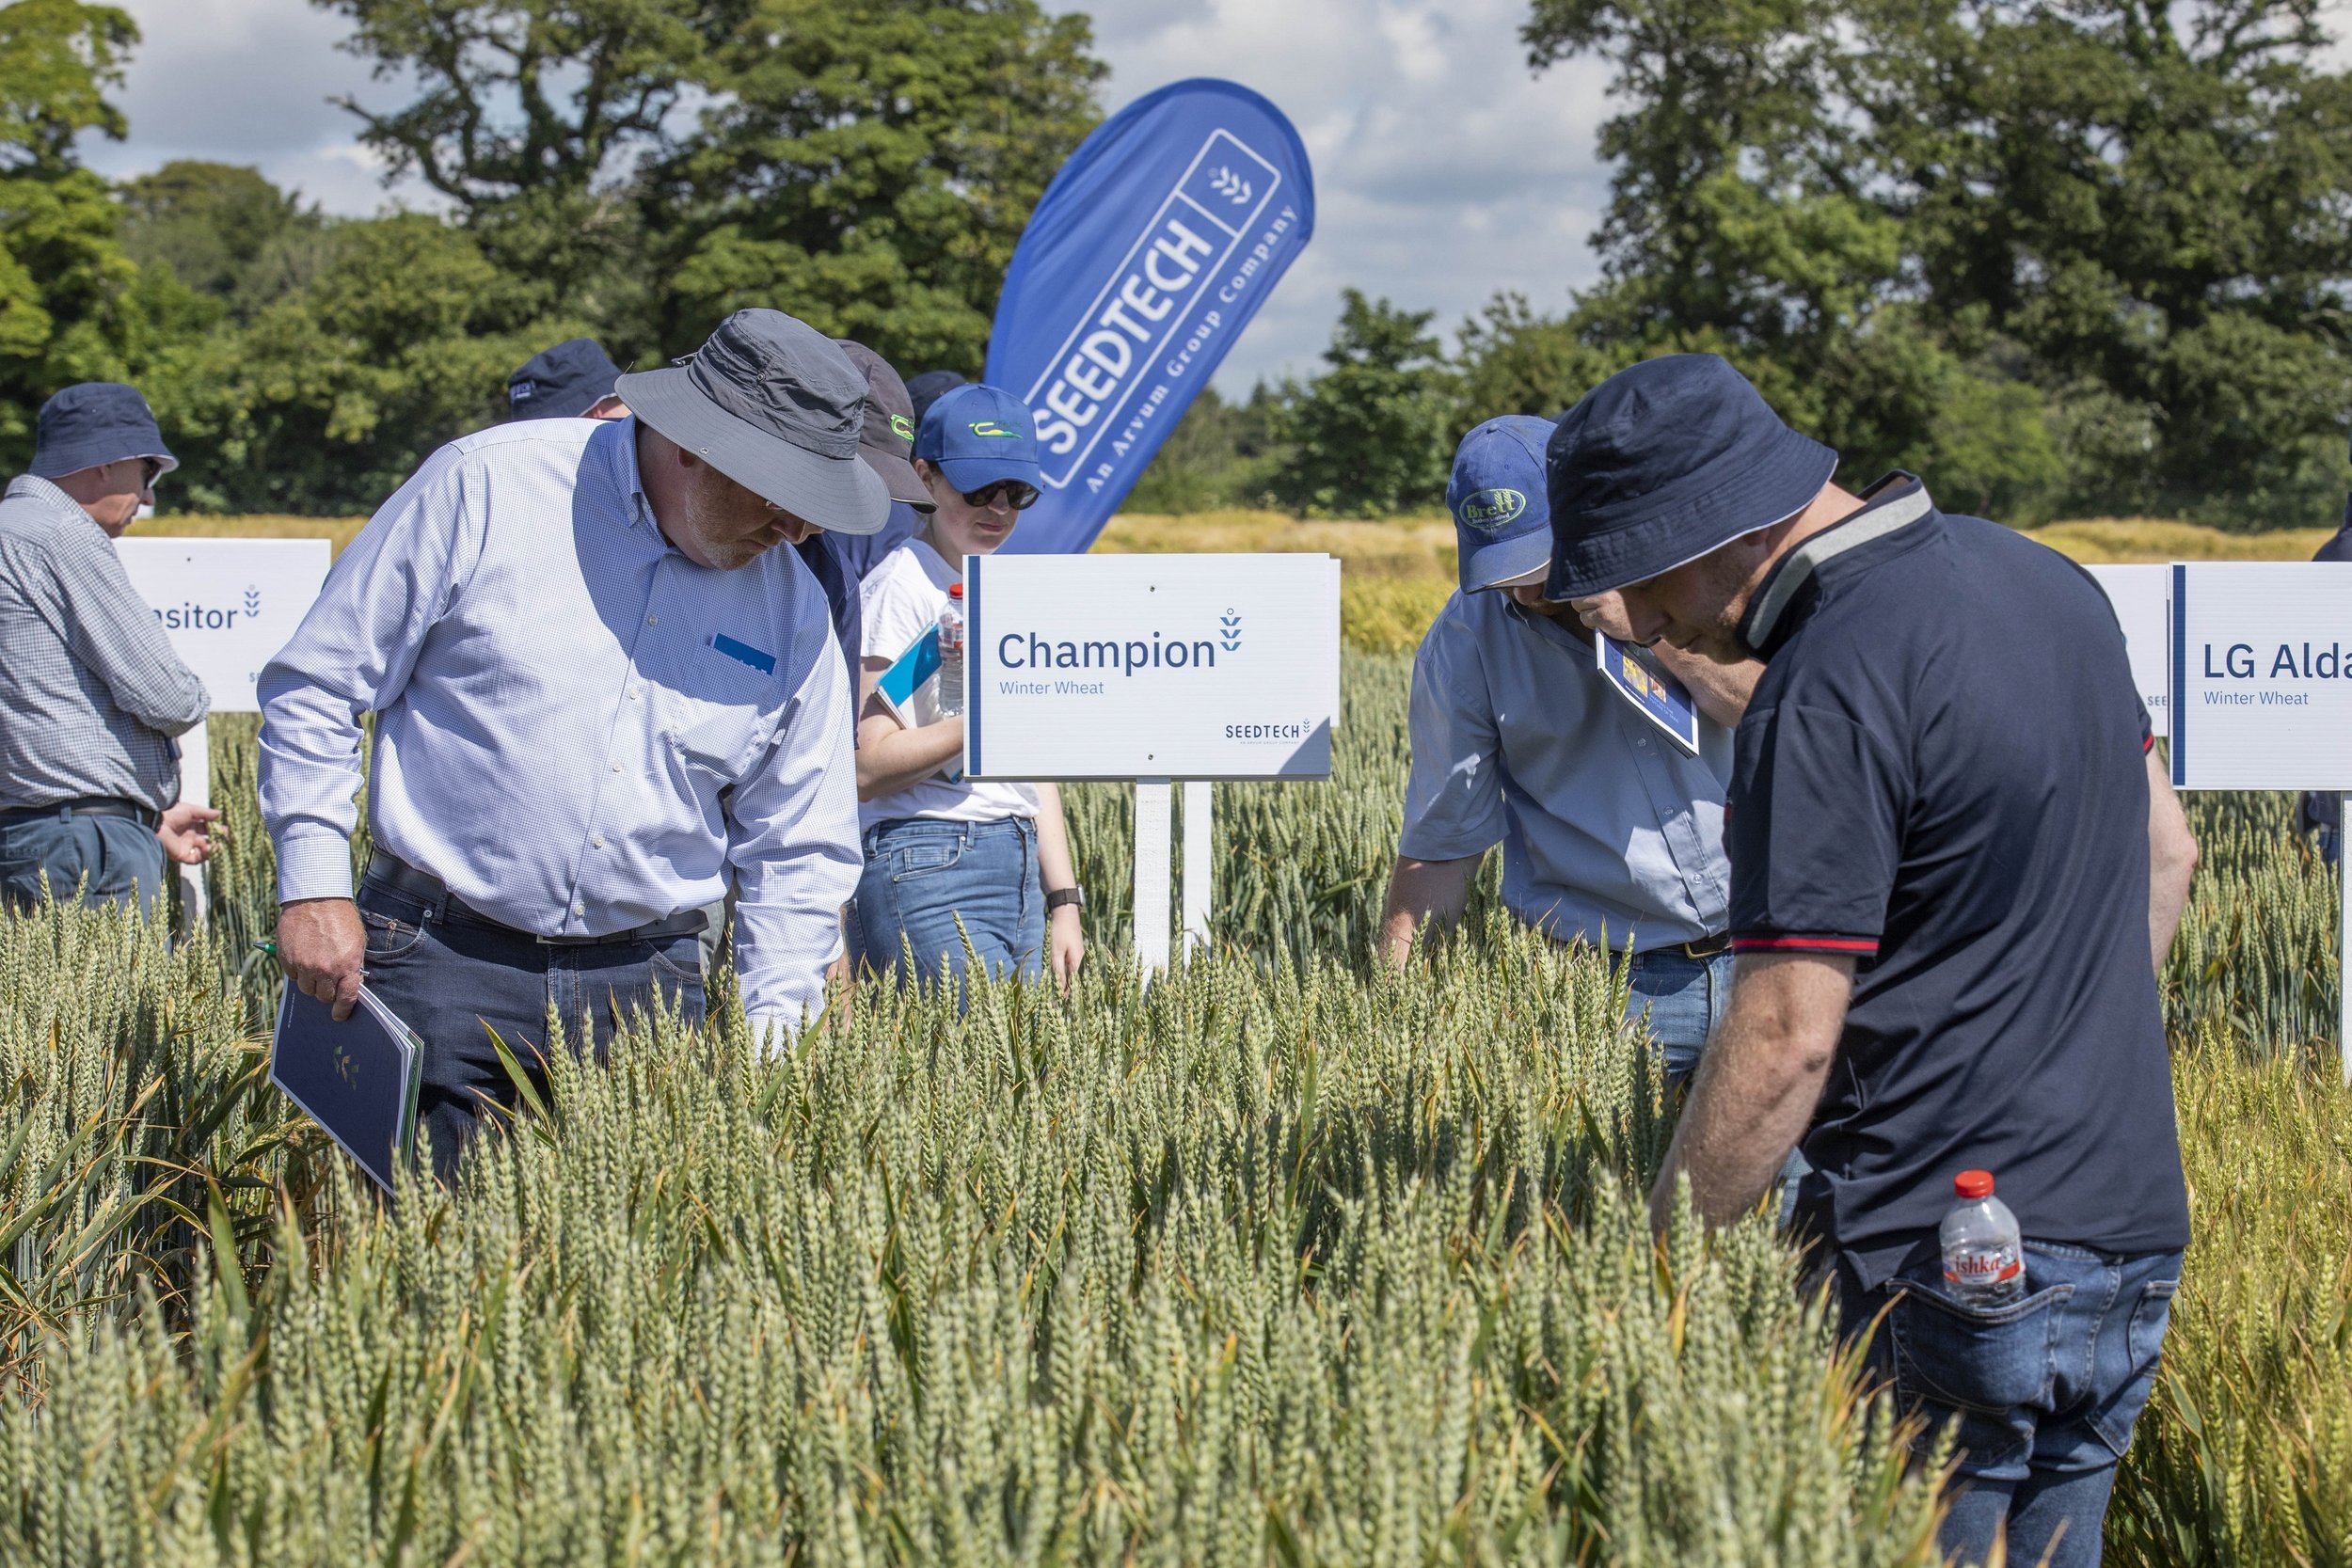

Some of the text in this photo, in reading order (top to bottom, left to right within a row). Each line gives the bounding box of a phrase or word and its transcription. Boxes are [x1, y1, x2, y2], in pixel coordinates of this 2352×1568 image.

[1034, 218, 1214, 454] SEEDTECH
[1087, 204, 1298, 493] An Arvum Group Company
[1467, 489, 1515, 518] Brett
[998, 631, 1216, 677] Champion
[2204, 643, 2255, 679] LG
[999, 680, 1104, 695] Winter Wheat
[2203, 690, 2309, 705] Winter Wheat
[1225, 724, 1300, 738] SEEDTECH
[1956, 1255, 2000, 1274] ishka
